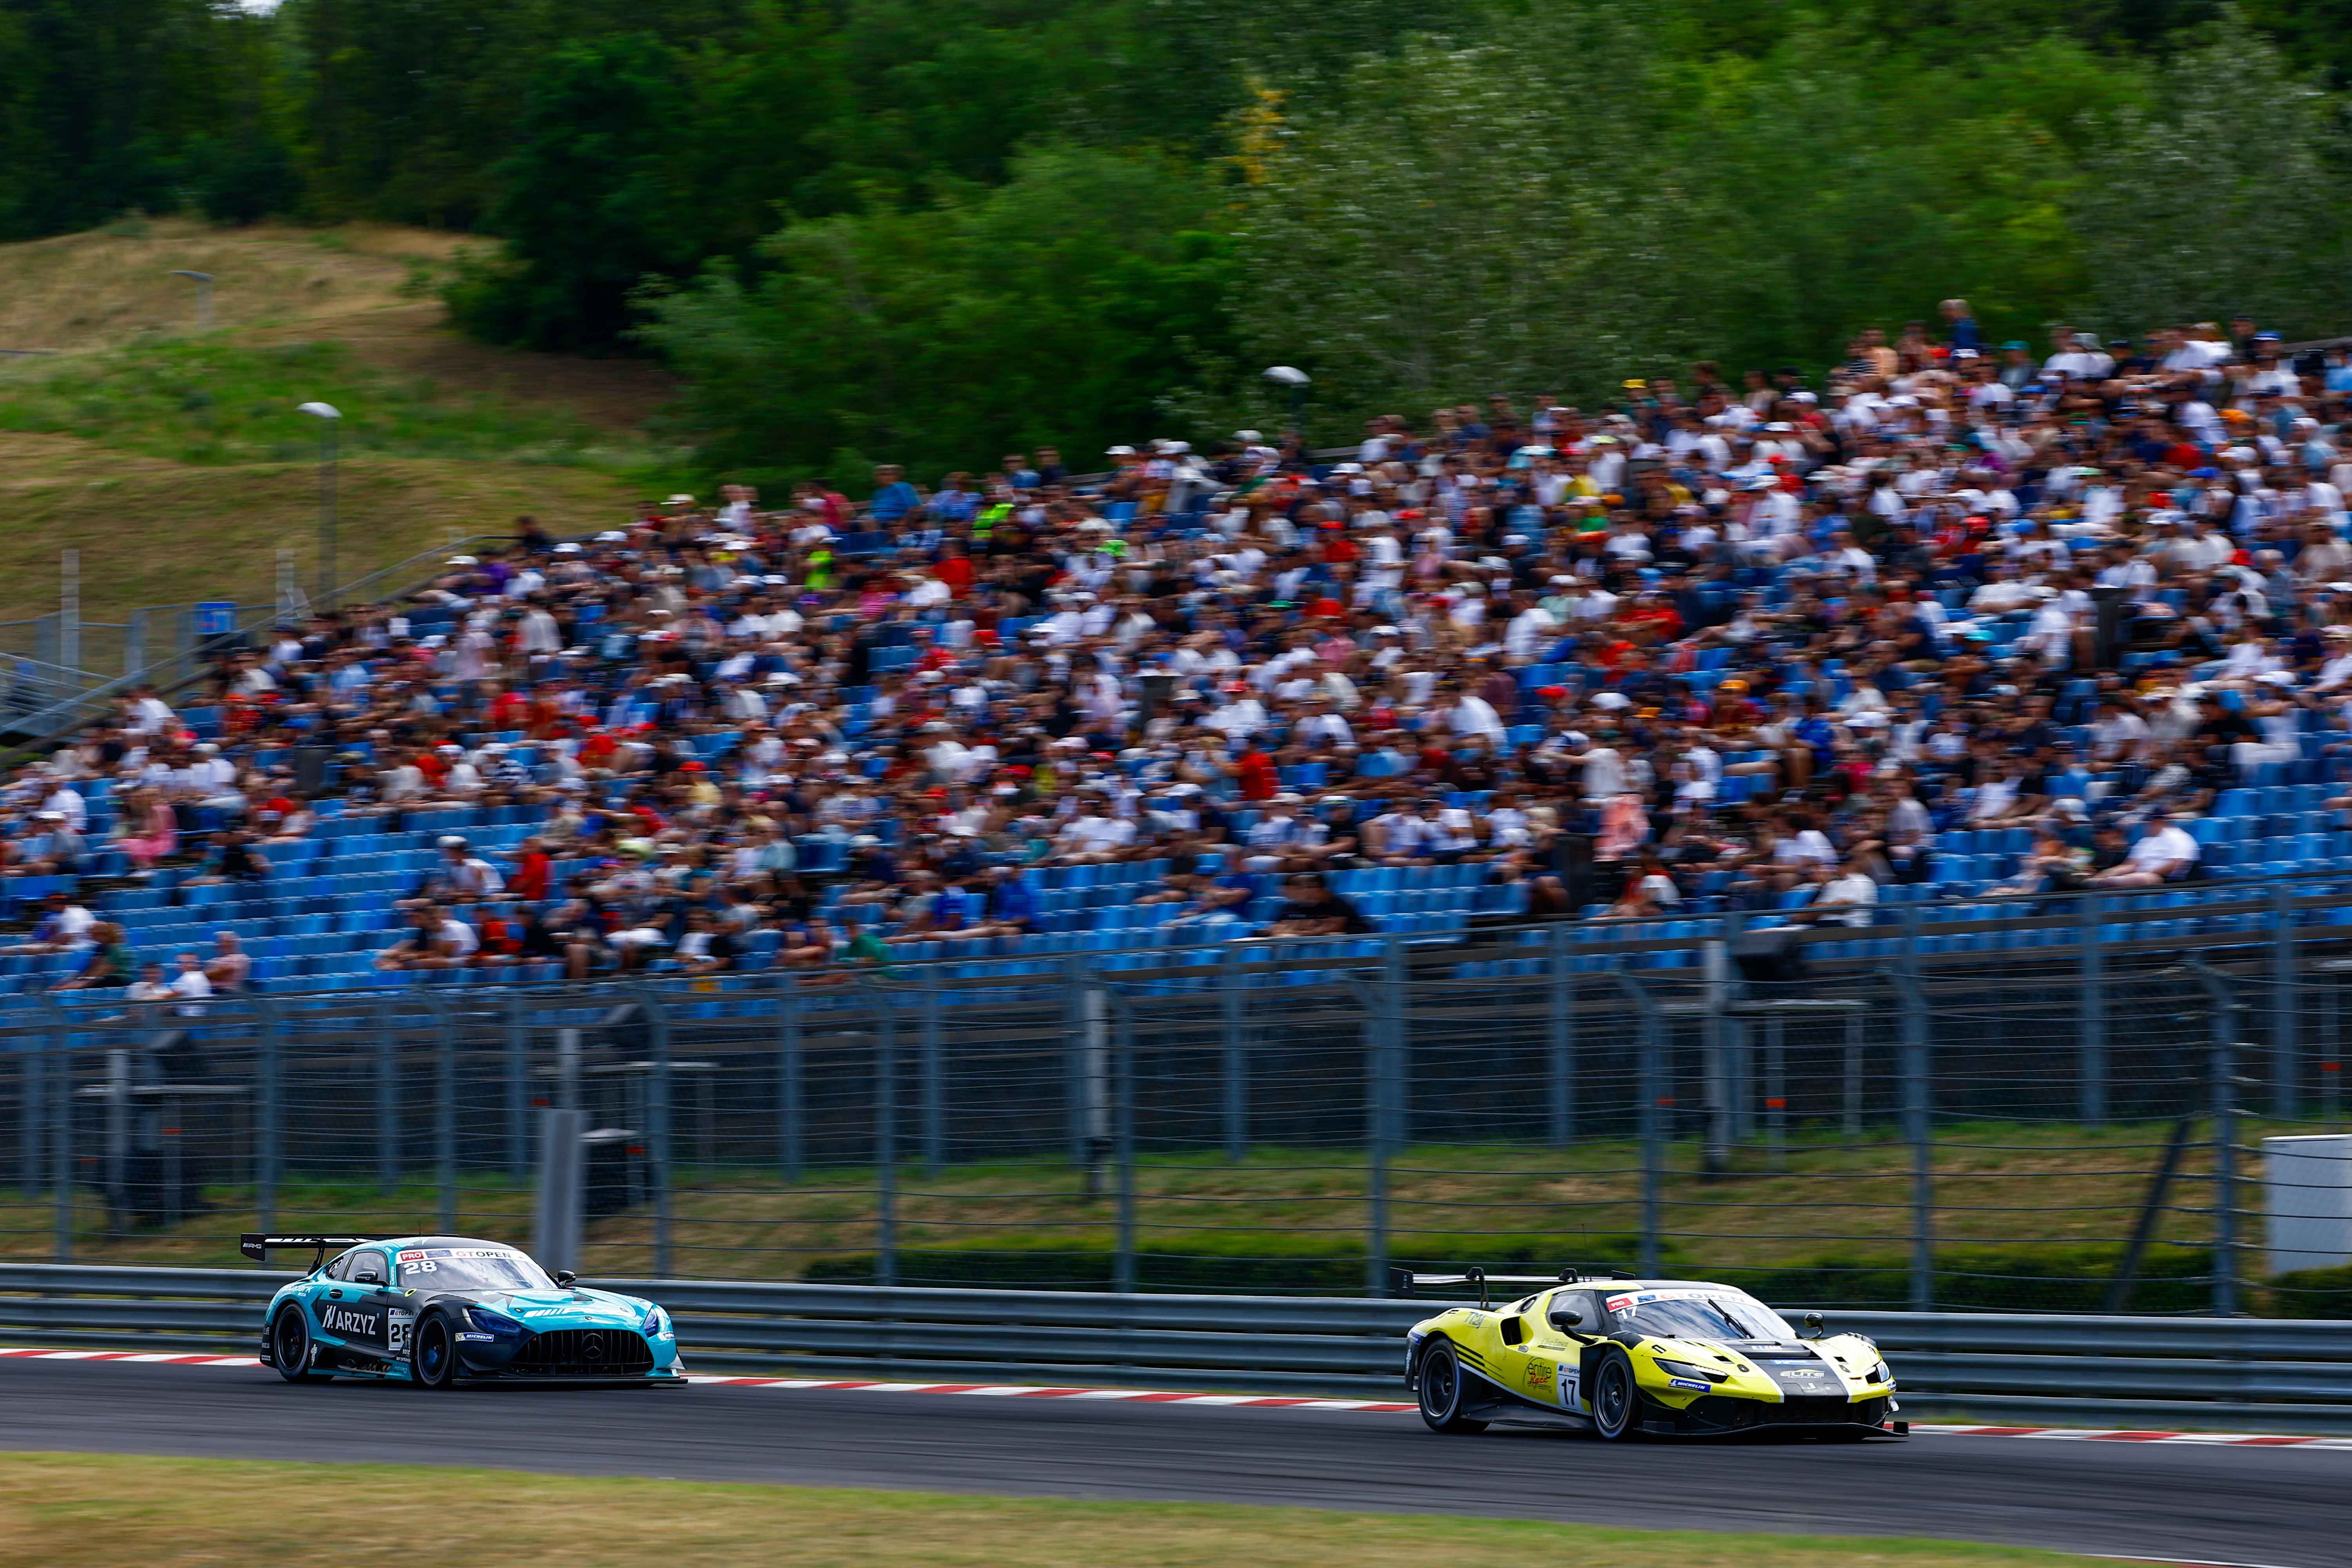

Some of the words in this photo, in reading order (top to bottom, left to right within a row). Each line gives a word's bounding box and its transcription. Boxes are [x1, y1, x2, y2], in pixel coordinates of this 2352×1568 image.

[404, 1261, 437, 1275] 28
[1611, 1297, 1625, 1307] PRO
[1618, 1306, 1637, 1320] 17
[391, 1323, 412, 1343] 28
[1528, 1361, 1551, 1379] entire
[1530, 1373, 1549, 1384] Race
[1561, 1379, 1576, 1406] 17
